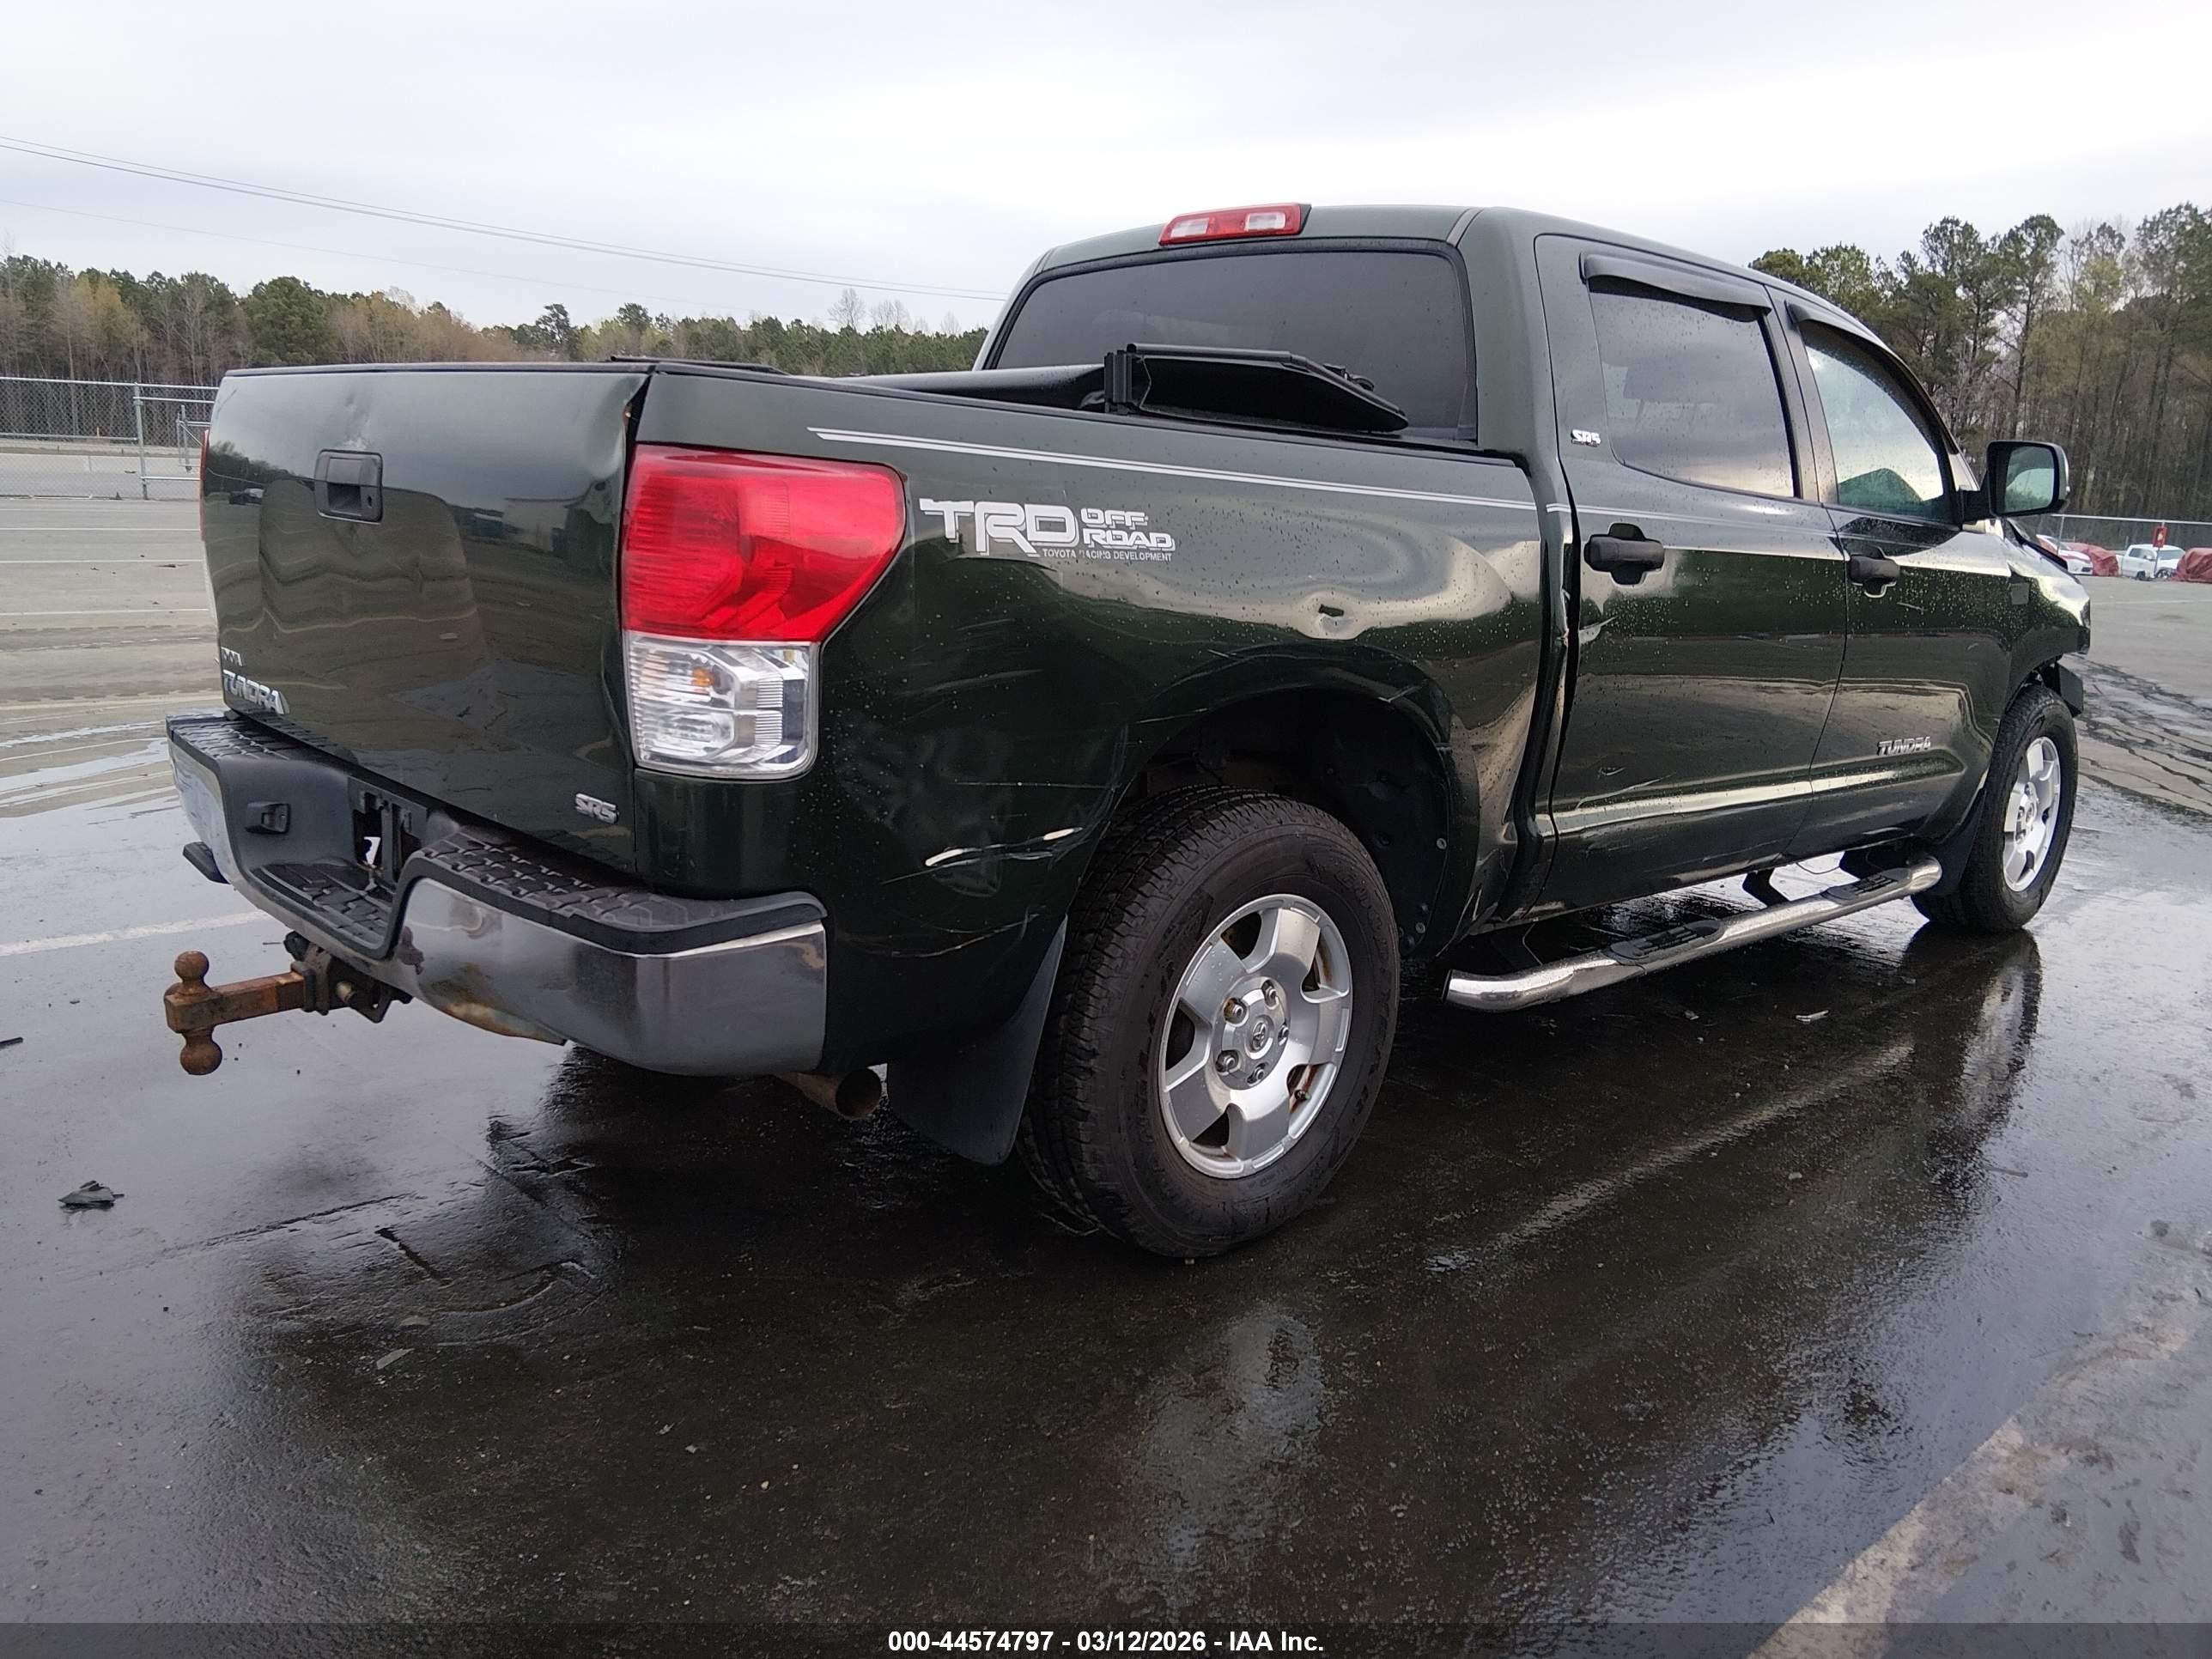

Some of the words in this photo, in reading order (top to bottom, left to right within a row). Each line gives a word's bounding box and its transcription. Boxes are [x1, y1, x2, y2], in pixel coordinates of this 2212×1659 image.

[919, 498, 1079, 557] TRD
[1080, 507, 1148, 528] OFF
[1082, 528, 1176, 551] ROAD
[1042, 548, 1077, 558] TOYOTA
[1113, 550, 1172, 562] DEVELOPMENT
[574, 793, 617, 824] SR5
